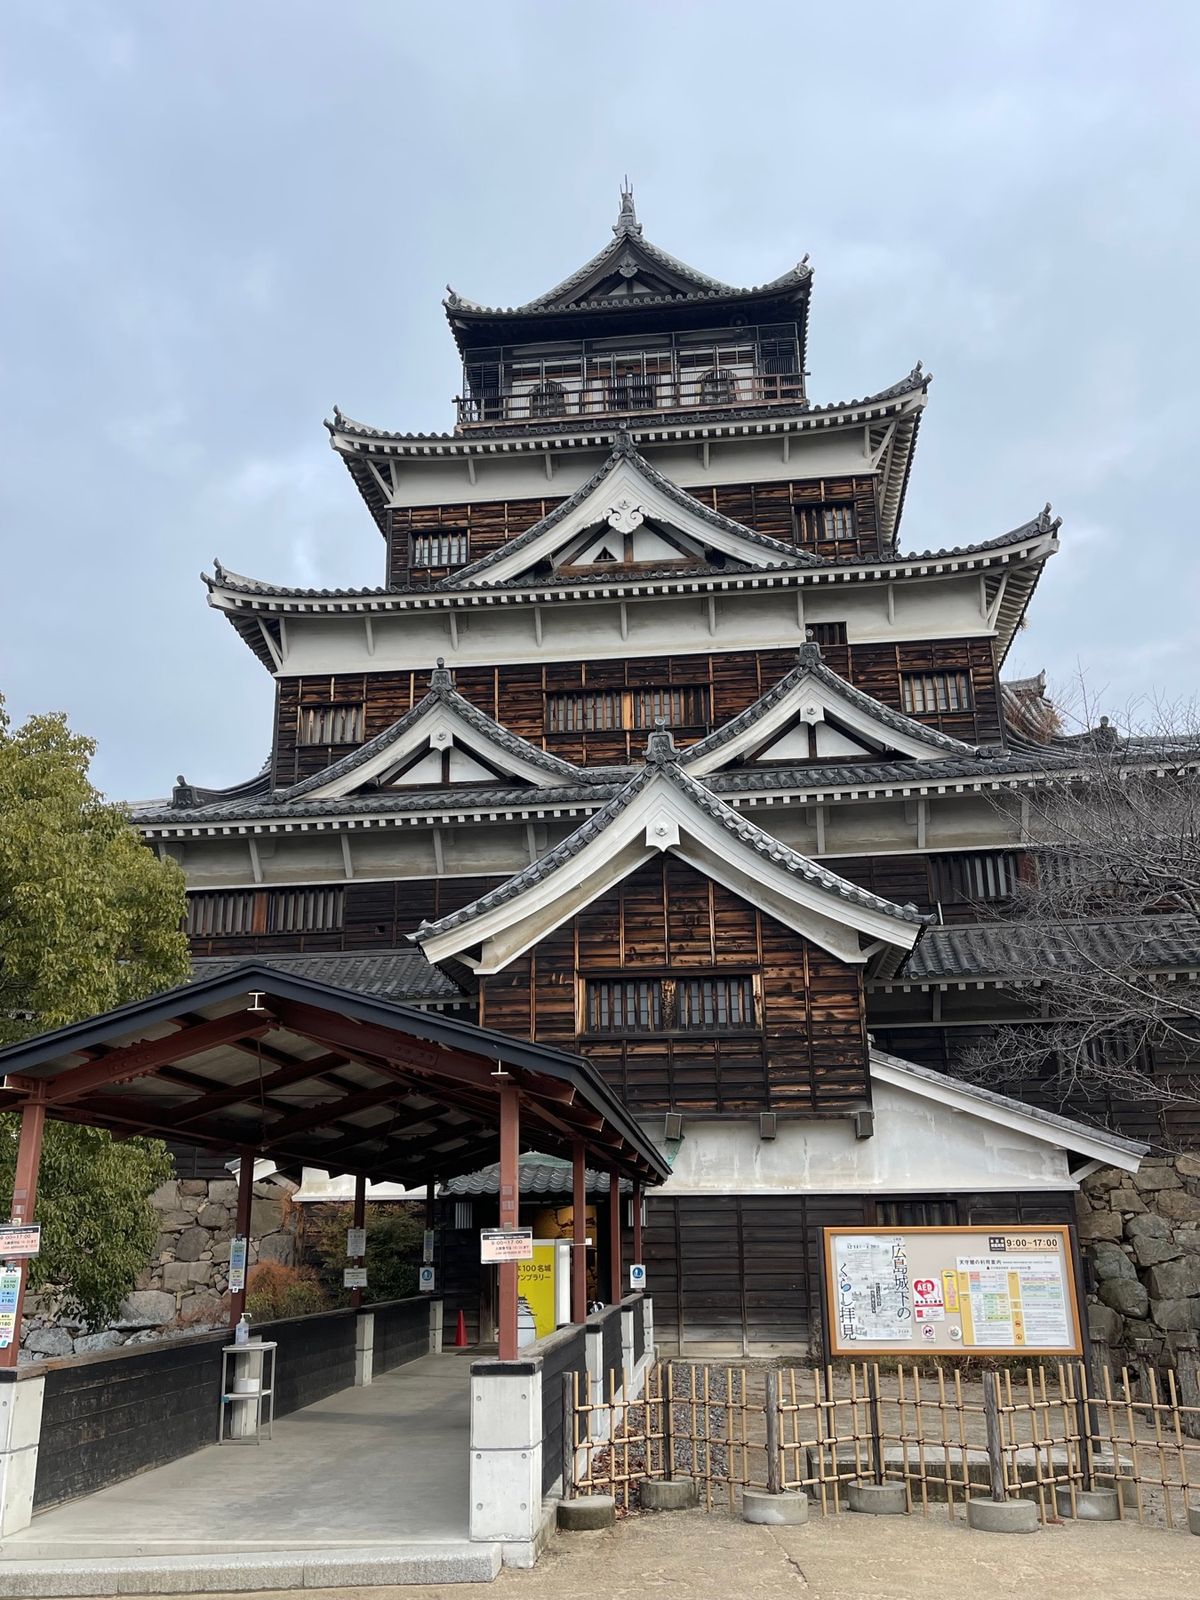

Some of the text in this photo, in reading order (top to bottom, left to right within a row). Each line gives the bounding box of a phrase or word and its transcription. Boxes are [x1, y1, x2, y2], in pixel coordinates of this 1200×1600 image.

[839, 1262, 857, 1341] くらし拝見
[891, 1243, 911, 1320] 広島城下の
[917, 1283, 933, 1292] AED
